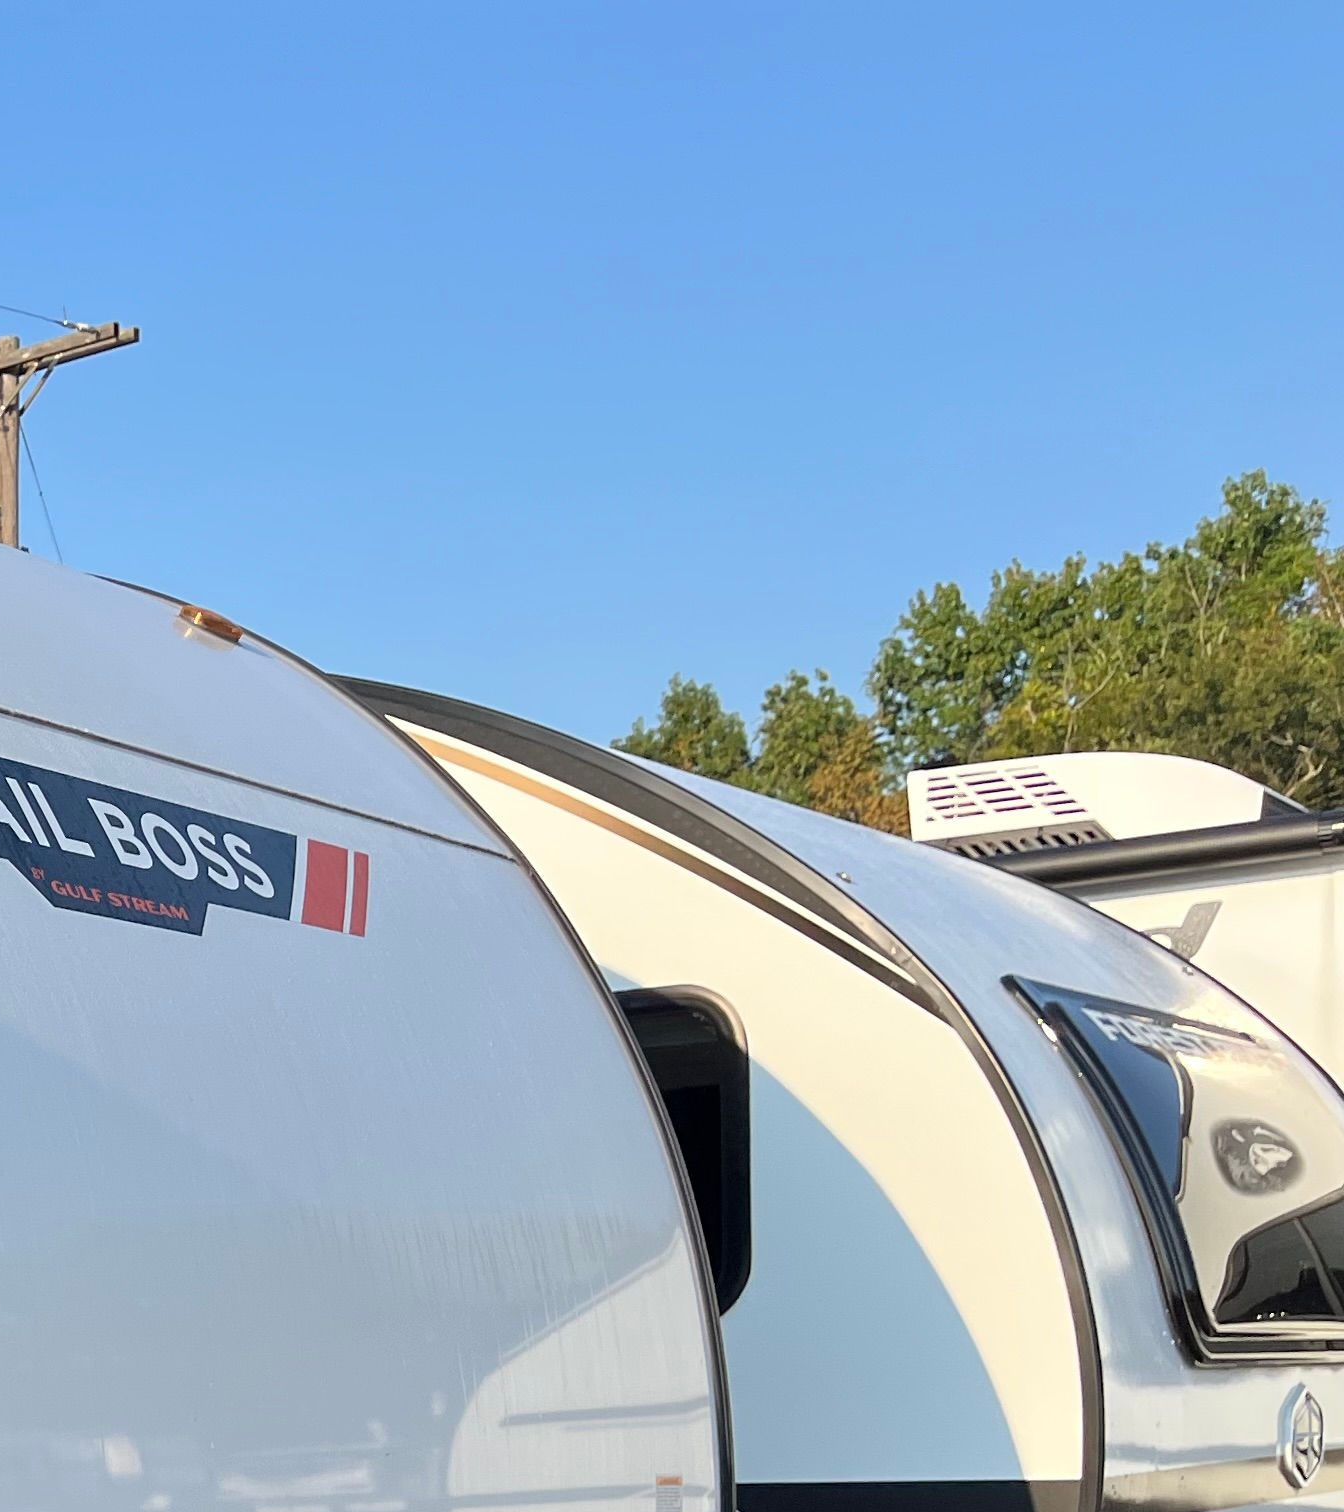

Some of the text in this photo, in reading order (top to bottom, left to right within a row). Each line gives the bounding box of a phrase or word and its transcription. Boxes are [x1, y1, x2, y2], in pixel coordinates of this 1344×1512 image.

[88, 798, 277, 899] BOSS
[30, 866, 190, 921] BY GULF STREAM
